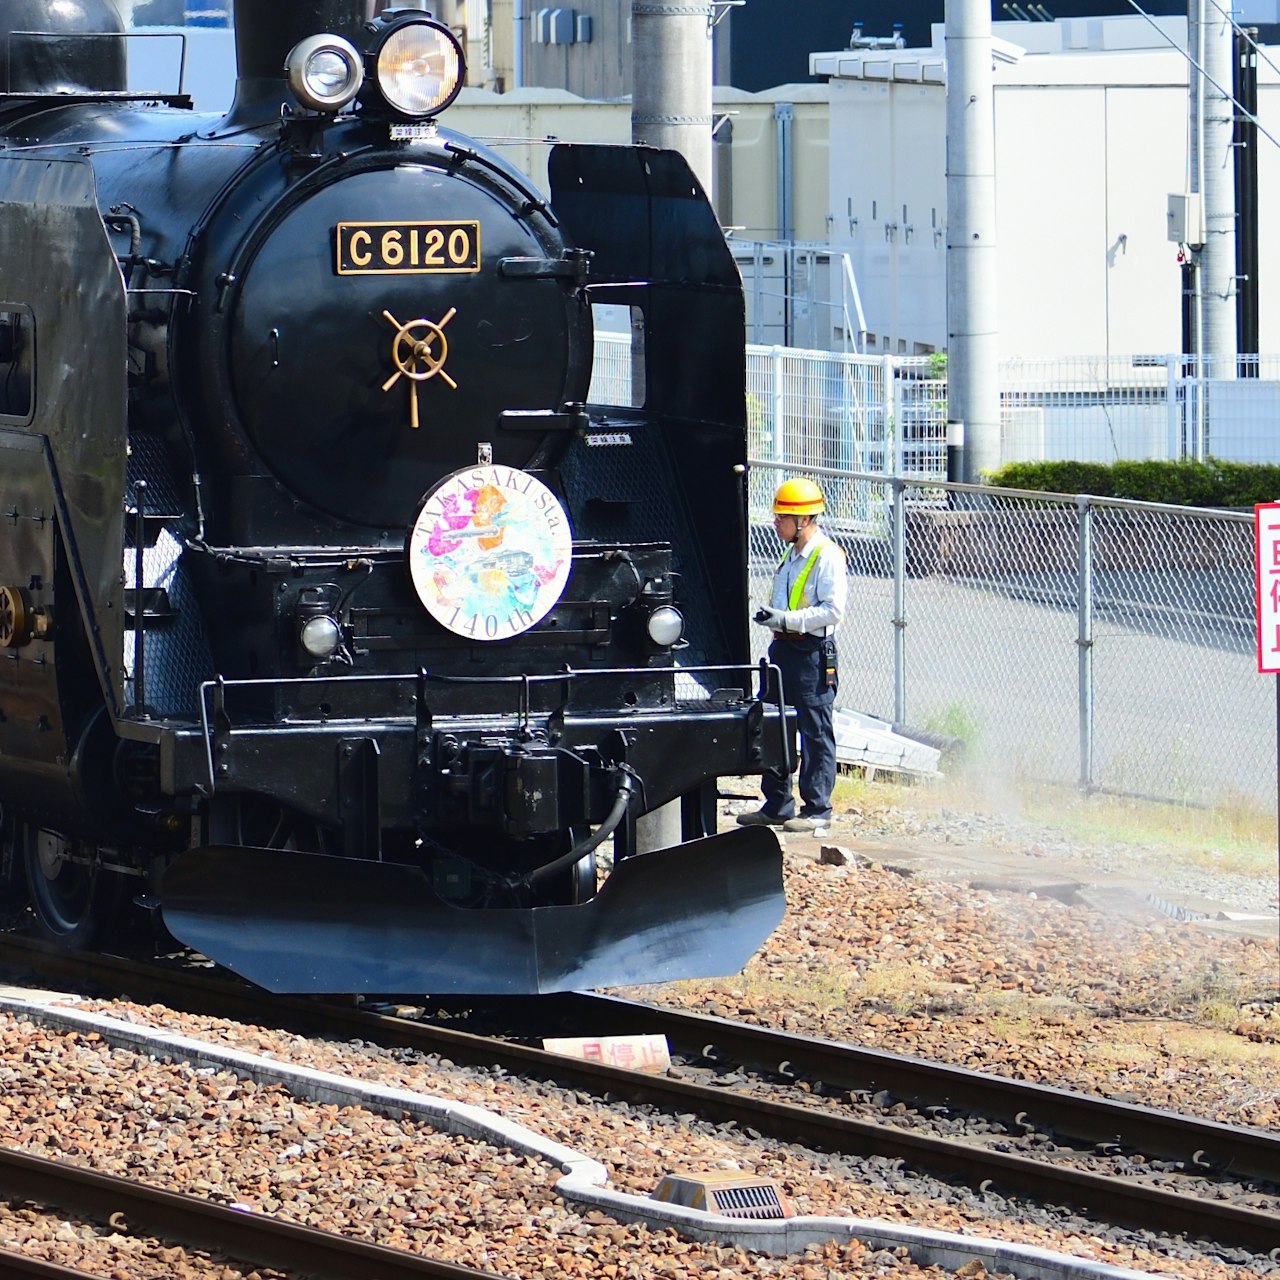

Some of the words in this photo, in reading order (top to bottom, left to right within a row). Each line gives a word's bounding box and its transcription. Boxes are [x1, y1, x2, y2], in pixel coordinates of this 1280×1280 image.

[349, 228, 470, 266] C6120
[416, 468, 535, 539] TAKASAKI
[533, 491, 562, 536] Sta.
